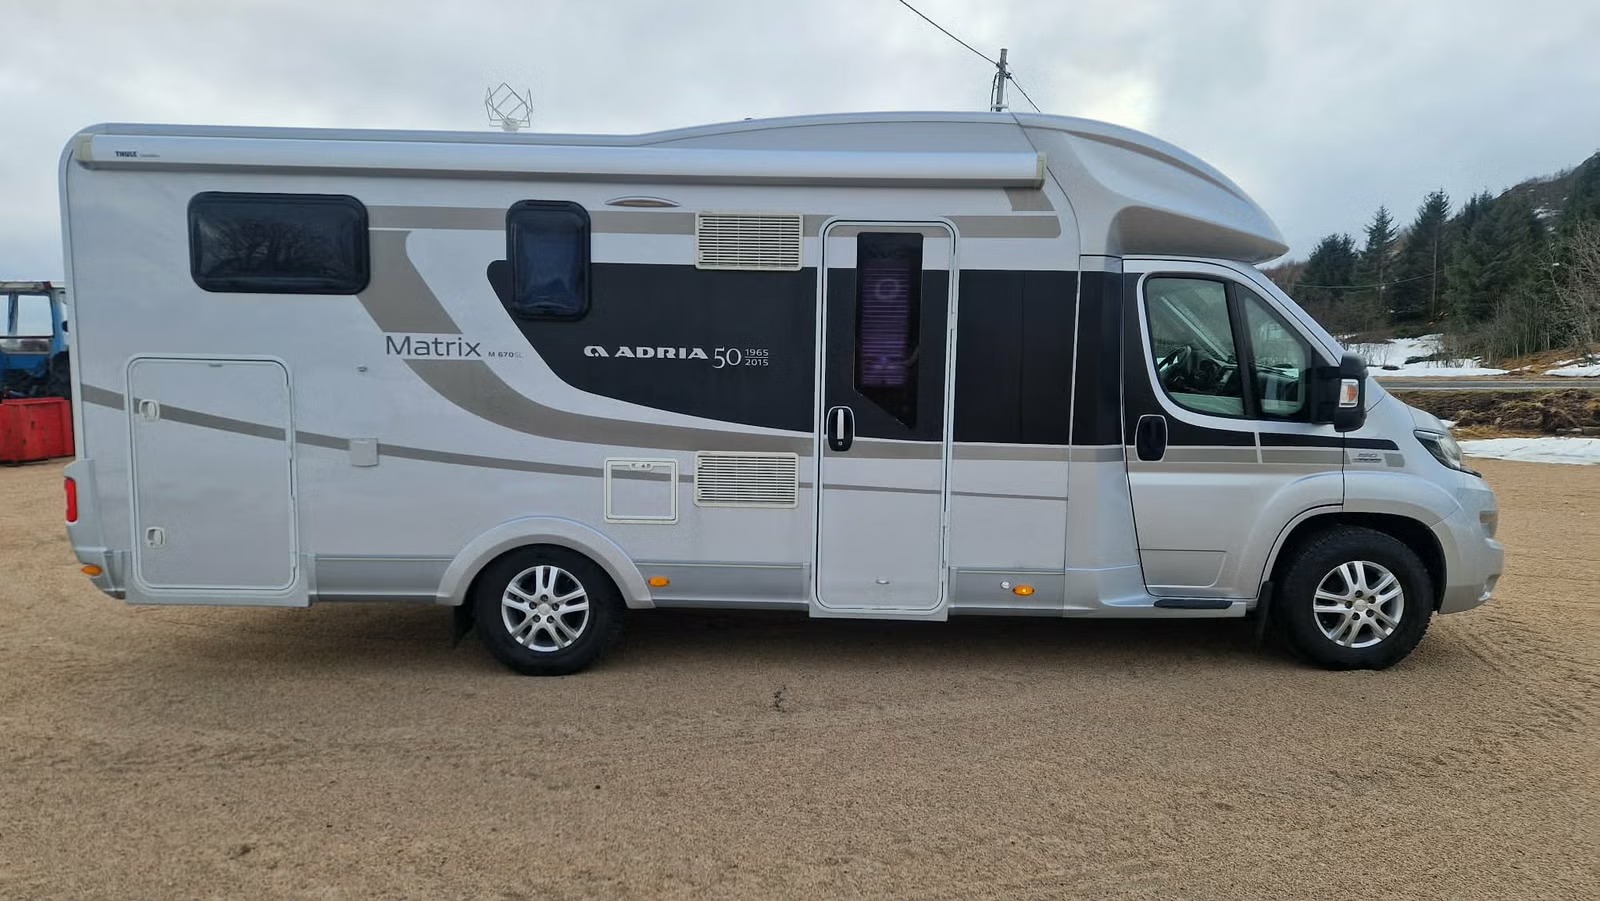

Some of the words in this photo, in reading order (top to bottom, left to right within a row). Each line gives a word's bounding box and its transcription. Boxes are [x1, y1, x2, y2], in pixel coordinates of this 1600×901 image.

[385, 335, 482, 357] Matrix
[744, 348, 769, 357] 1965
[614, 346, 709, 360] ADRIA
[712, 346, 742, 369] 50
[744, 358, 769, 367] 2015
